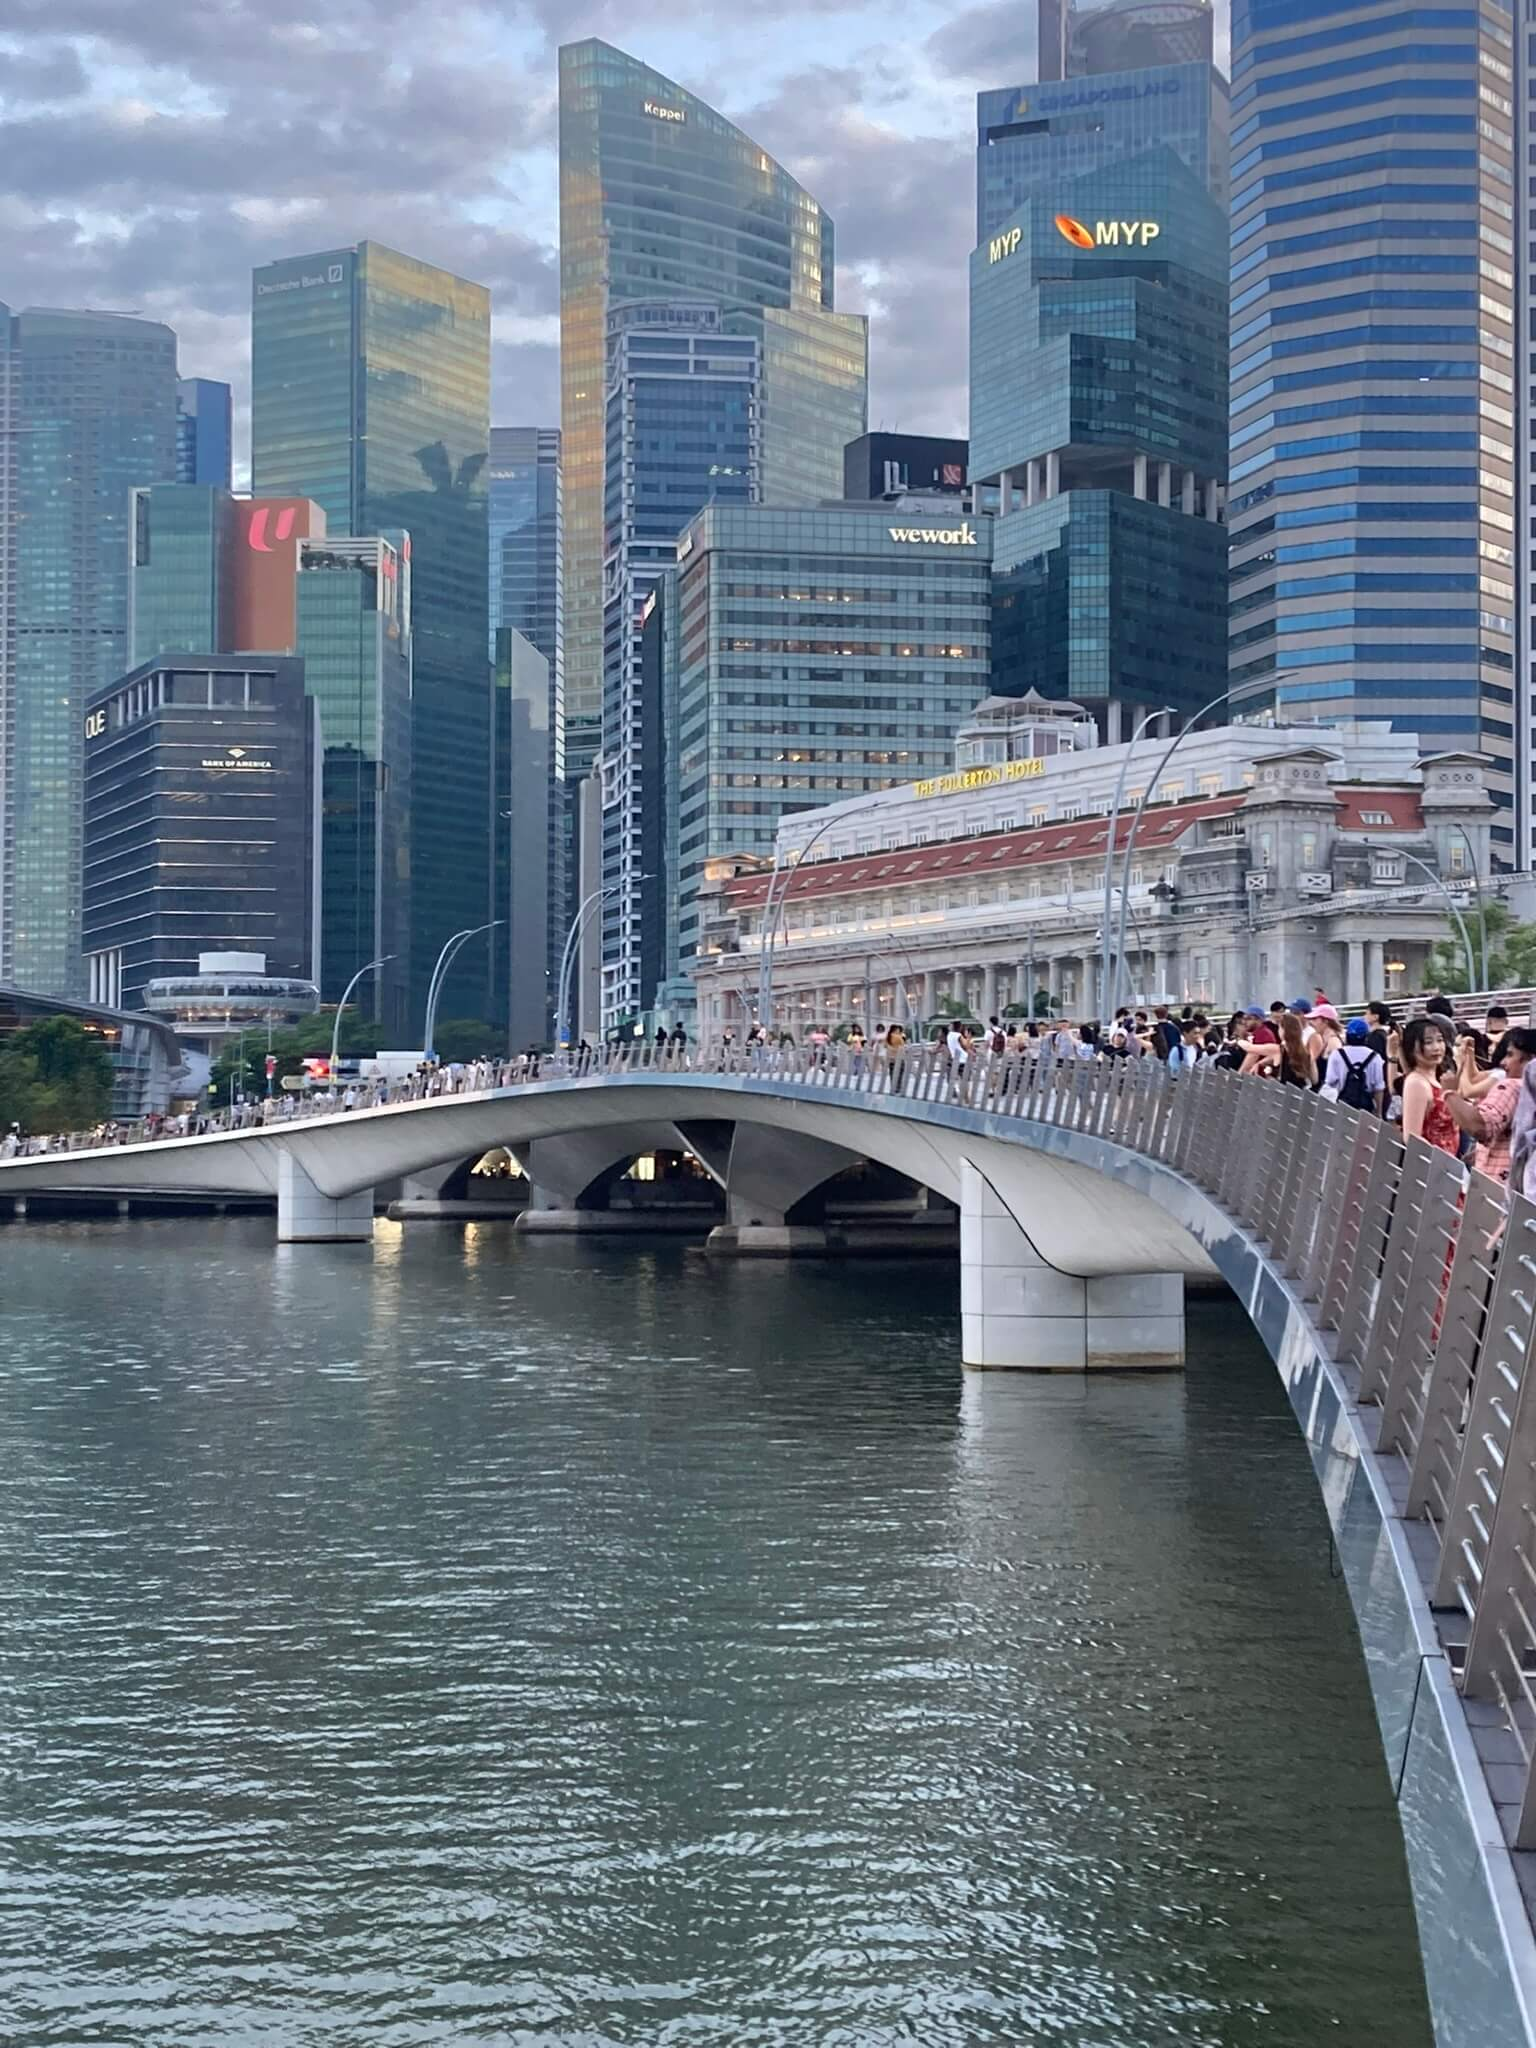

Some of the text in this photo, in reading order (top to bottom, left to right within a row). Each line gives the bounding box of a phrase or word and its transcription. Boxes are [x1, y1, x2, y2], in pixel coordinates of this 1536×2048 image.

[644, 101, 685, 122] Keppel
[990, 227, 1021, 264] MYP
[1096, 221, 1160, 246] MYP
[888, 522, 977, 544] wework
[86, 709, 105, 738] OUE
[236, 760, 272, 768] AMERICA
[914, 760, 1045, 800] THE FULLERTON HOTEL
